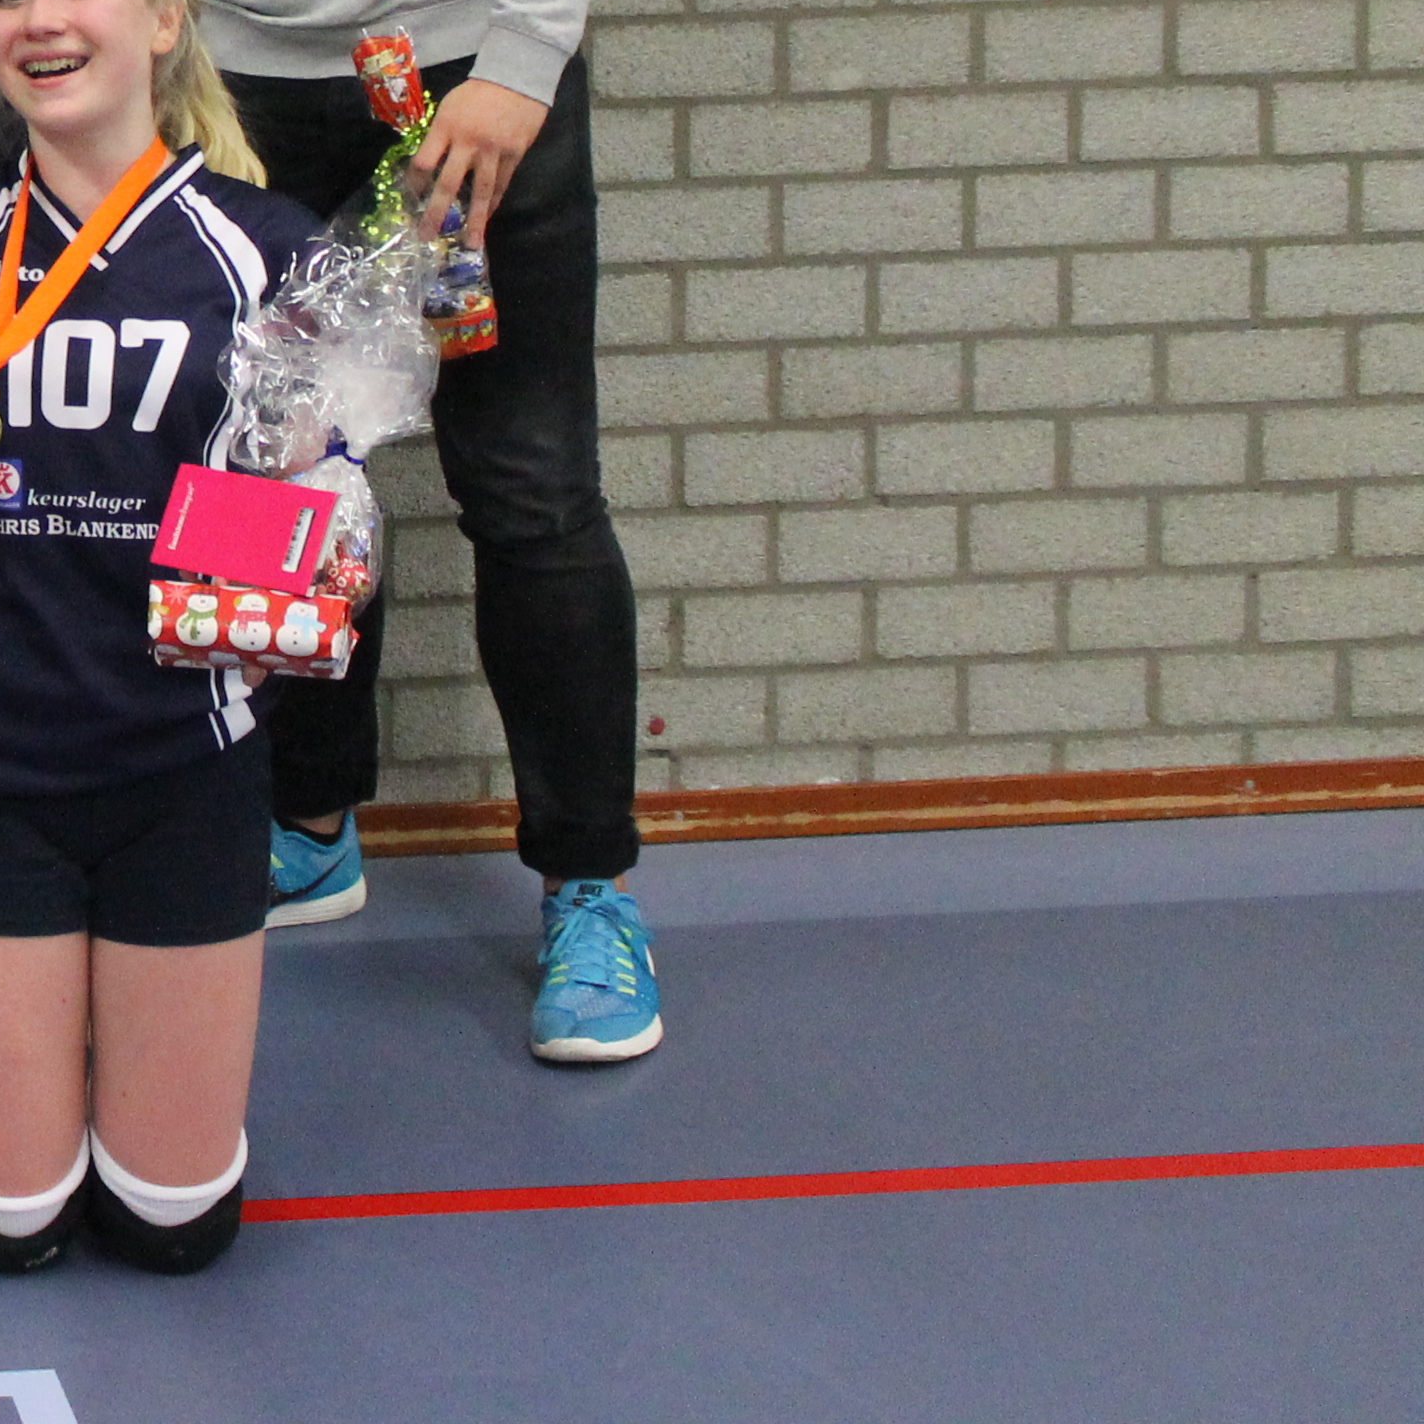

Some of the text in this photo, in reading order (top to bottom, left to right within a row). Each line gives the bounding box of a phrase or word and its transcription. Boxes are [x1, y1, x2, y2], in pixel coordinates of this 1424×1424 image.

[8, 318, 191, 432] 107
[27, 489, 146, 514] keurslager
[47, 514, 159, 540] BLANKEND
